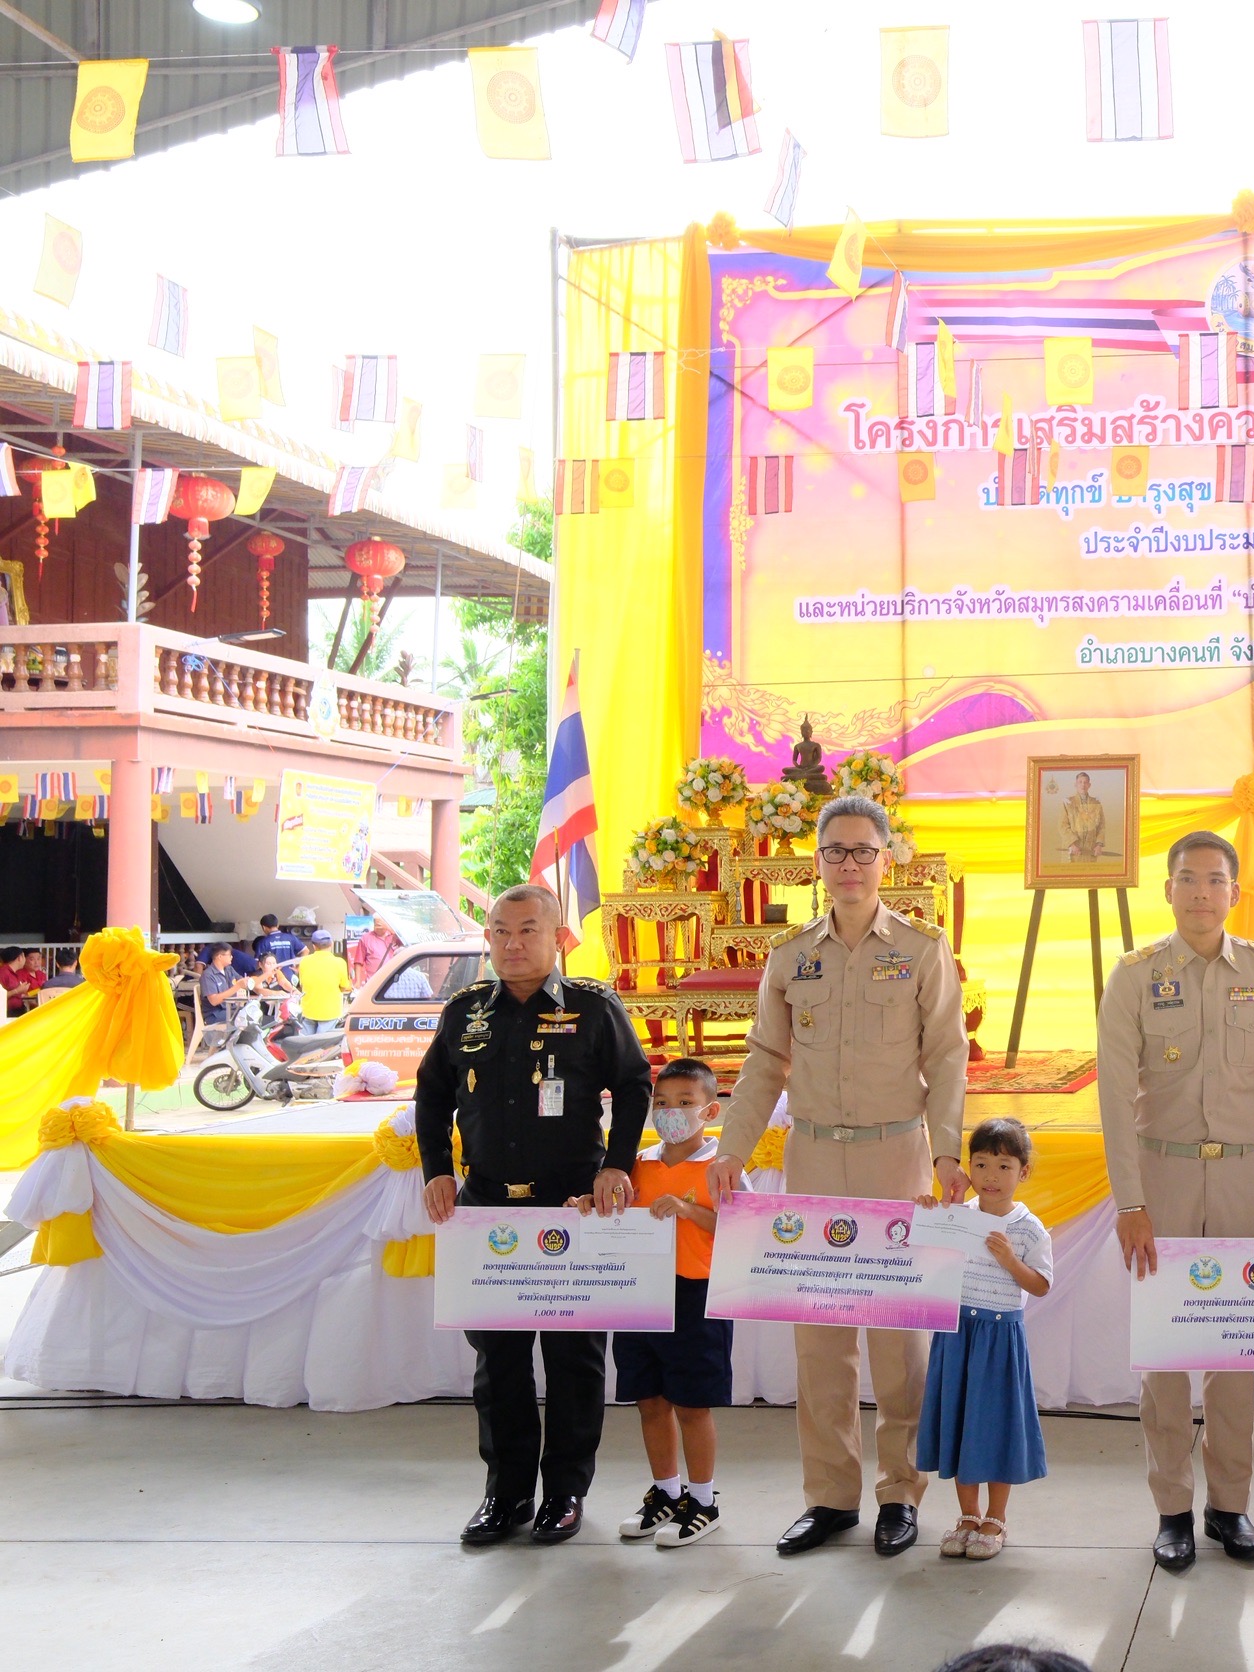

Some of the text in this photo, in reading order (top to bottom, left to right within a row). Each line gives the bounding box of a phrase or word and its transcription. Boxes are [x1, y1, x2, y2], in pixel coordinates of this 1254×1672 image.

[798, 579, 1224, 623] และหน่วยบริการจังหวัดสมุทรสงครามเคลื่อนที่
[1079, 635, 1222, 665] อำเภอบางคนที
[358, 1017, 407, 1030] FIXIT
[534, 1309, 557, 1317] 1,000
